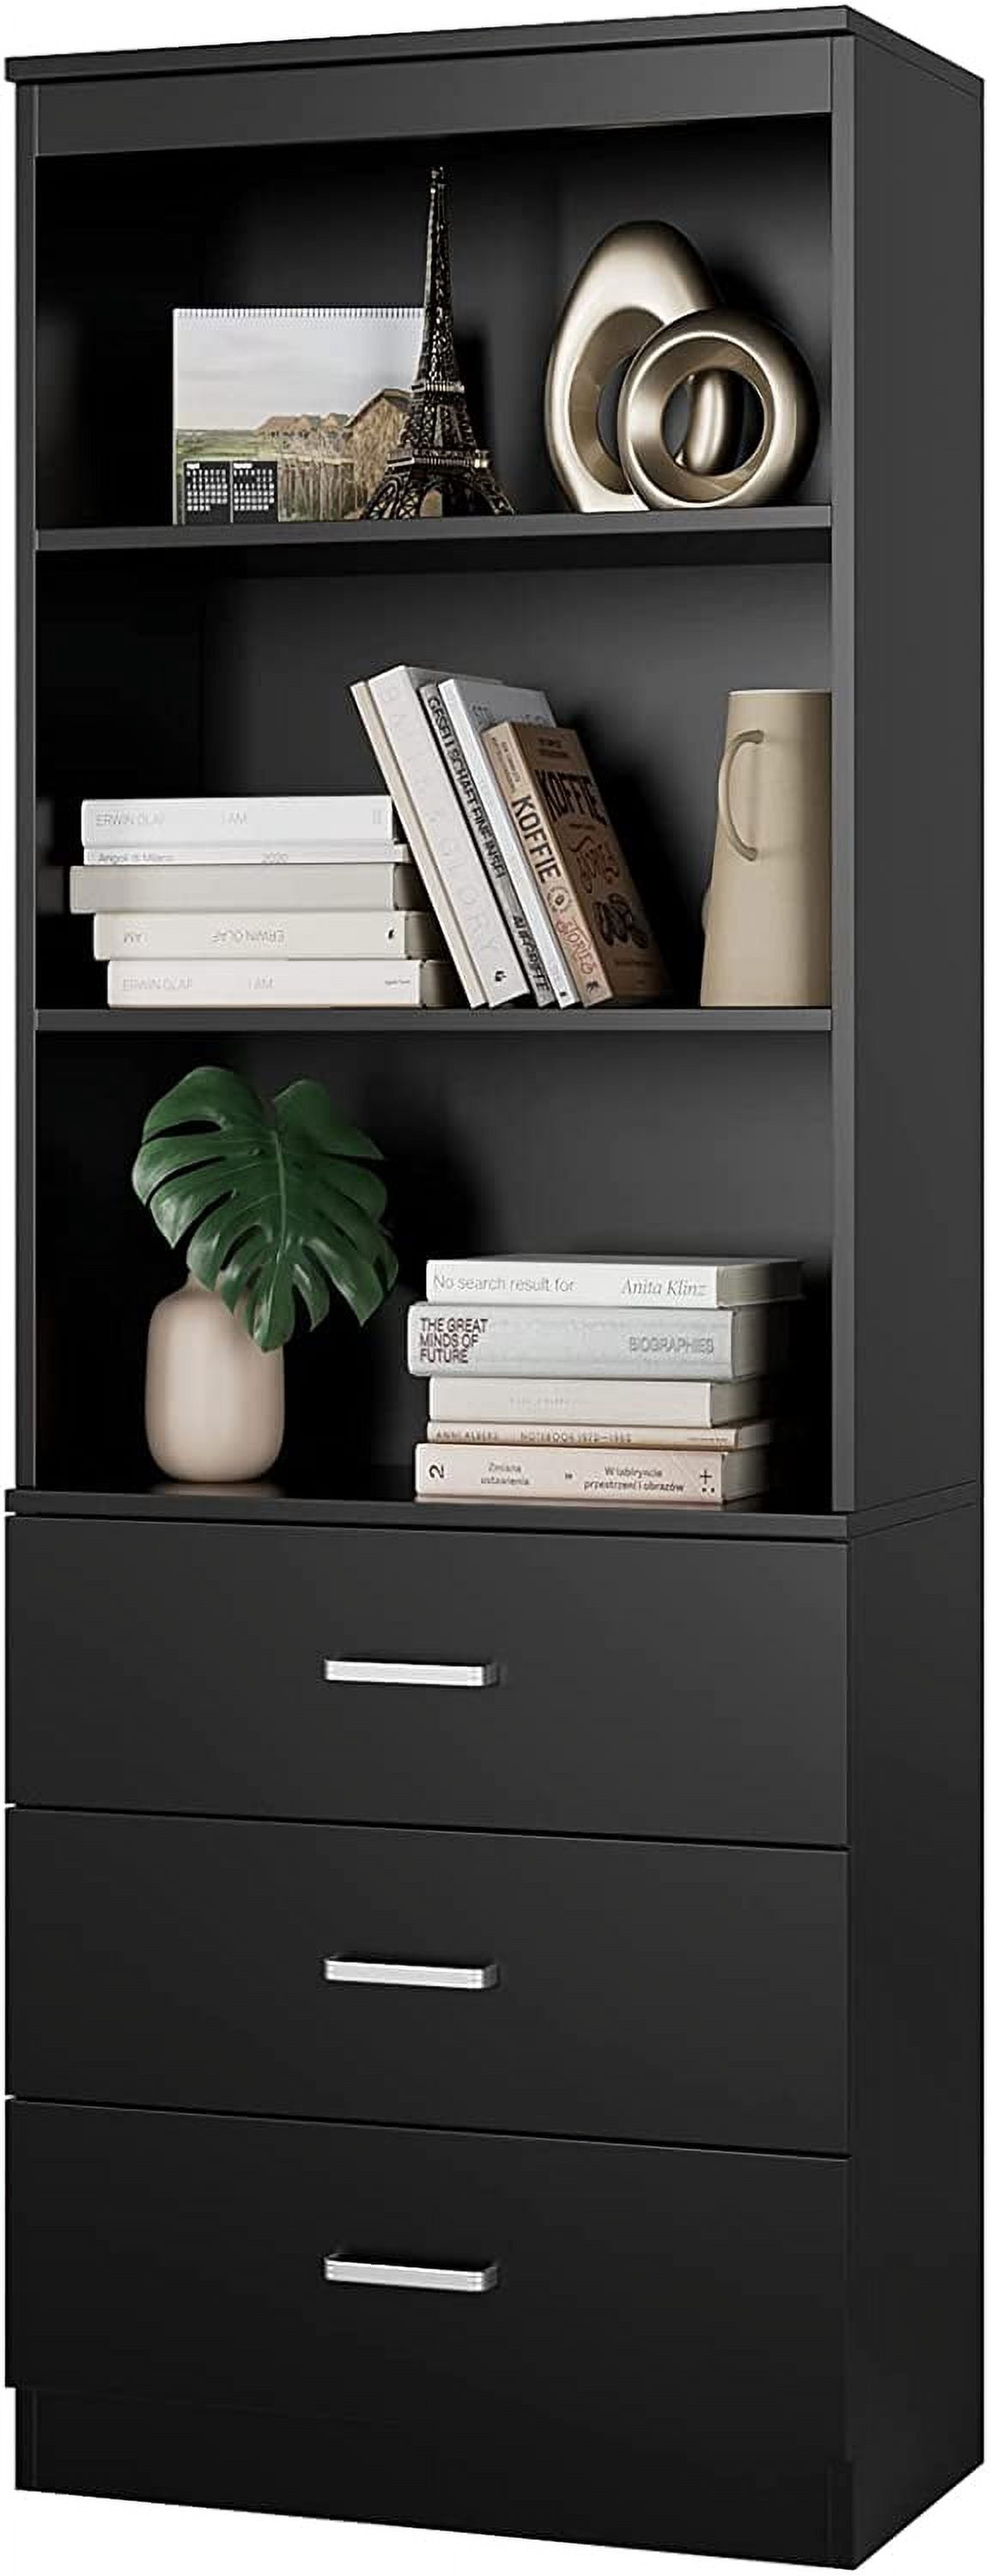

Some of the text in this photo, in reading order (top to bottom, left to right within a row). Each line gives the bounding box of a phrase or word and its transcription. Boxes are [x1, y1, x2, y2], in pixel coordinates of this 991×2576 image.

[512, 794, 561, 883] KOFFIE
[434, 1274, 575, 1292] No search result for
[622, 1278, 662, 1295] Anita
[420, 1318, 489, 1333] THE GREAT
[420, 1333, 479, 1347] MINDS OF
[629, 1336, 714, 1354] BIOGRAPHIES
[420, 1348, 469, 1364] FUTURE
[429, 1464, 445, 1479] 2
